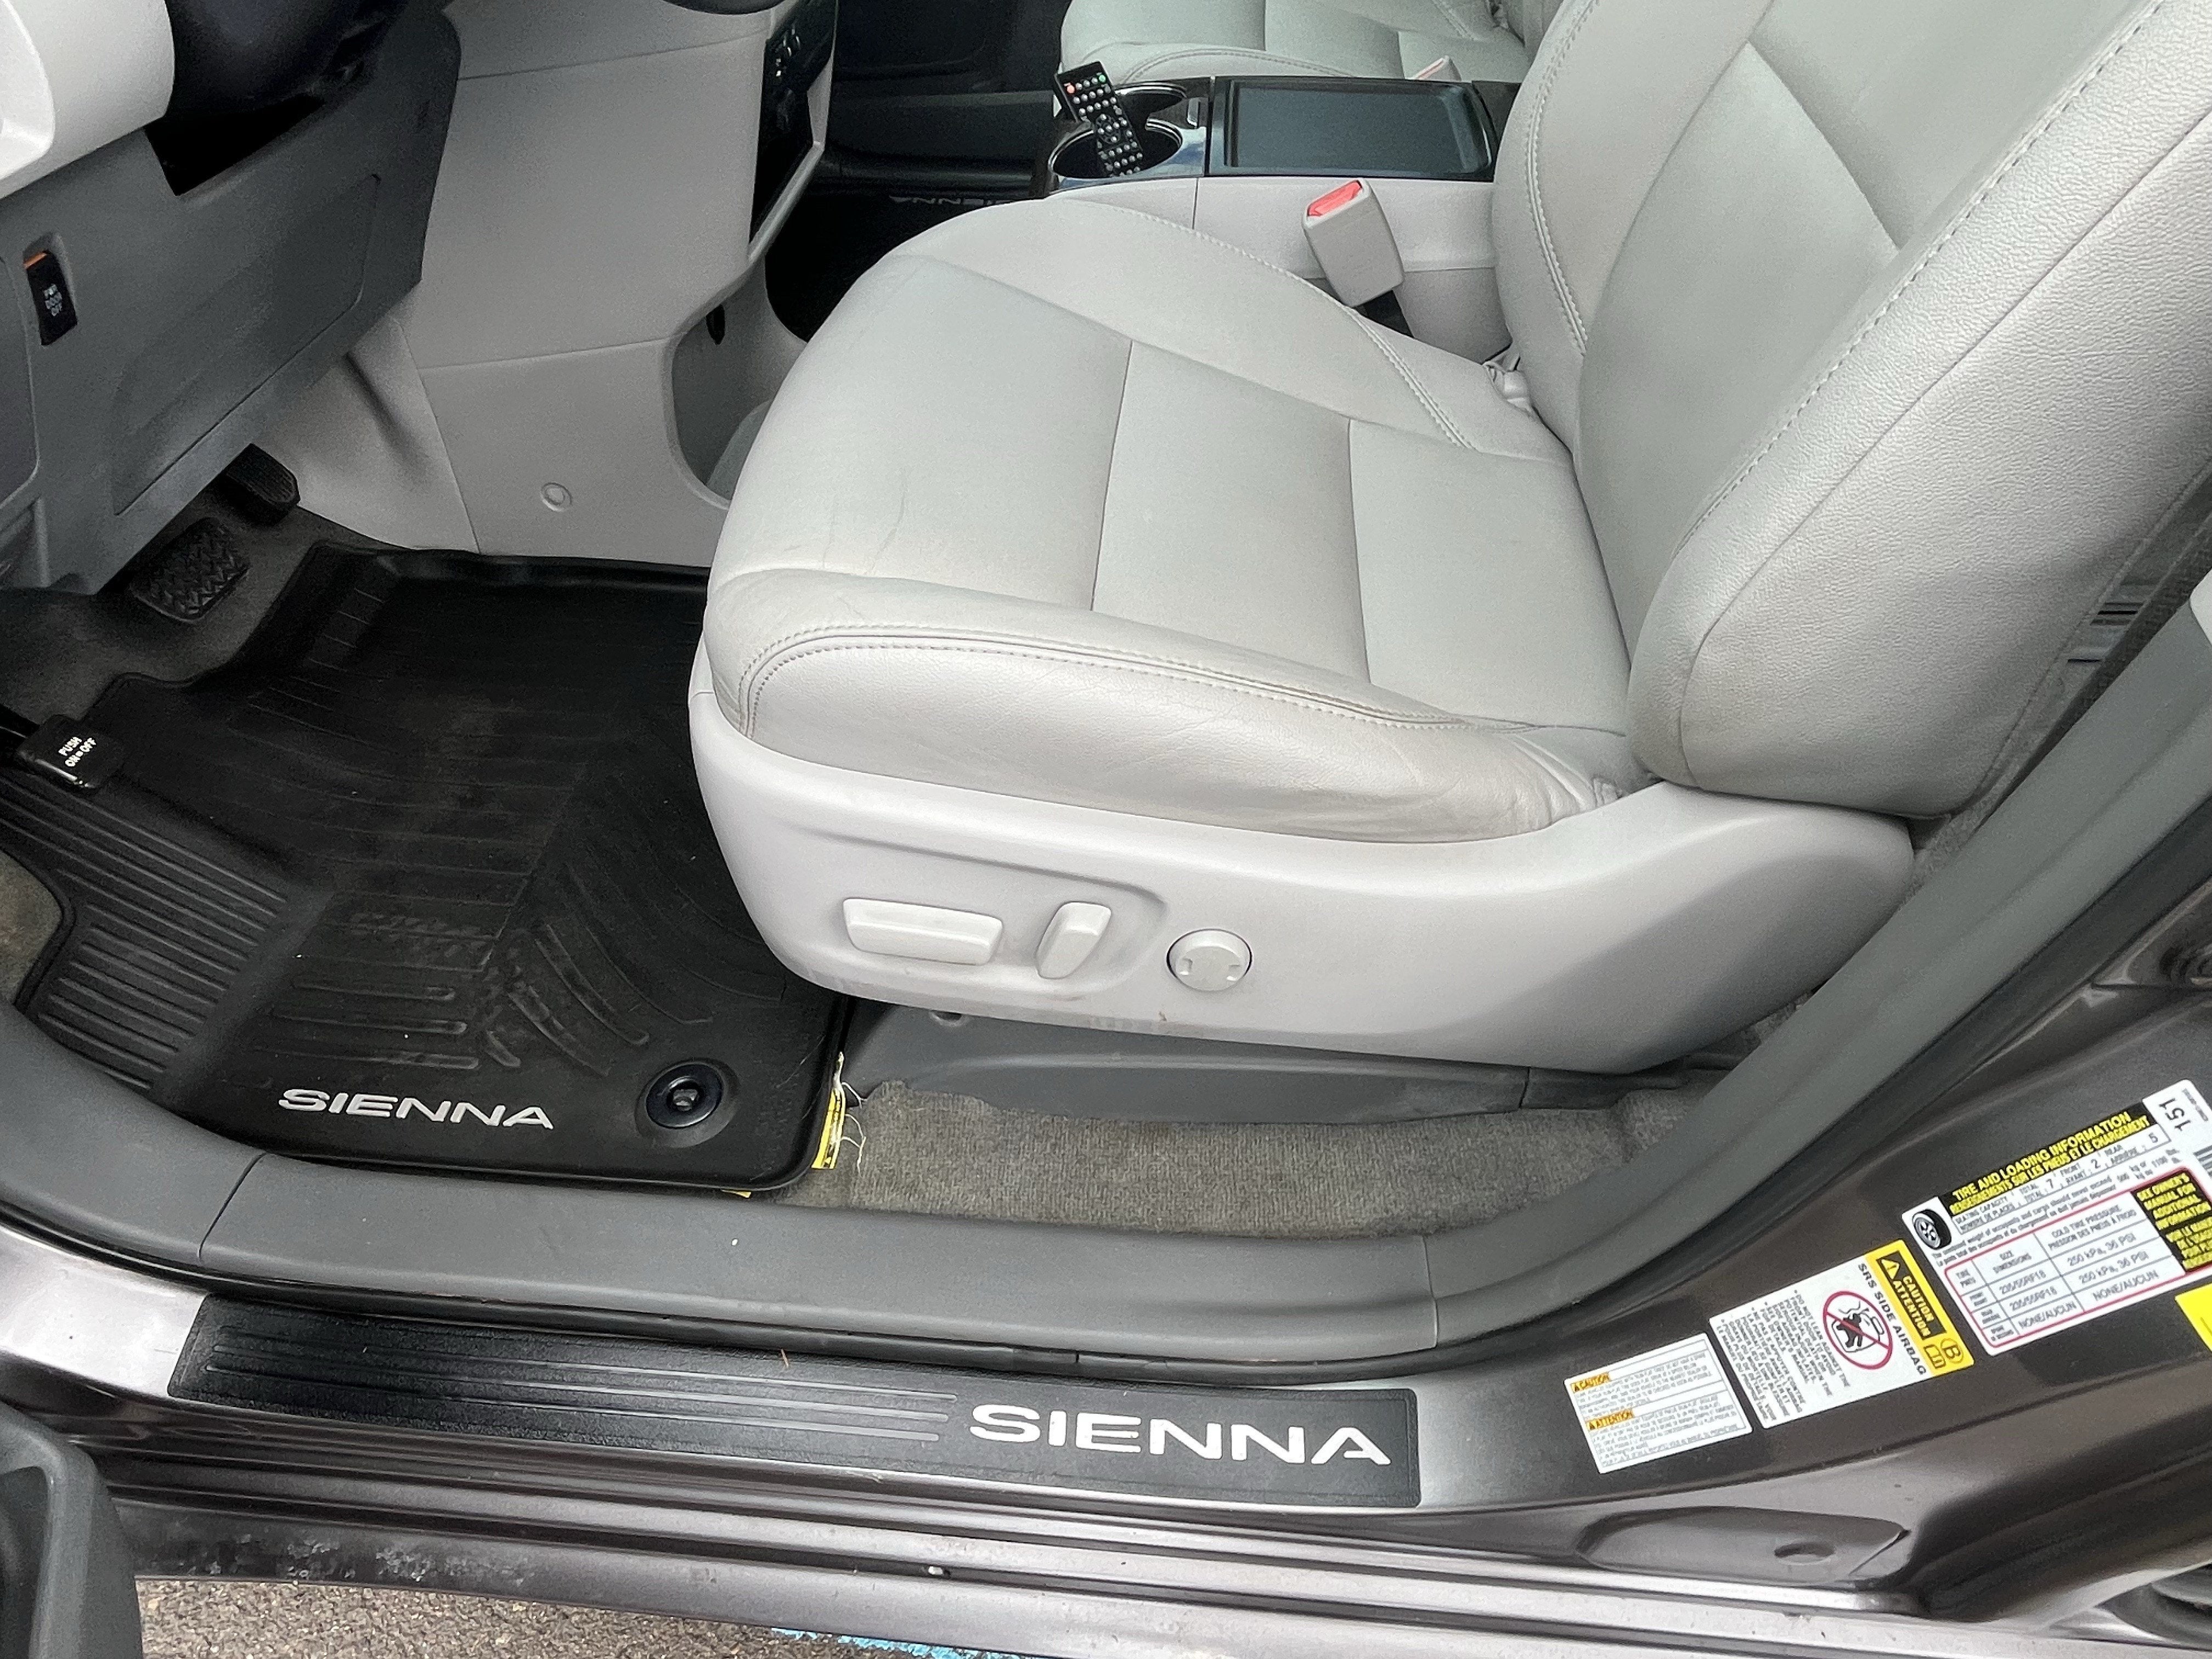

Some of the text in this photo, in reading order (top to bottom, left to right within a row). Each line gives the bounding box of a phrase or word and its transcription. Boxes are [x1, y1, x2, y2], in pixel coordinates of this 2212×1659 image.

[58, 736, 82, 756] PUSH
[278, 1088, 554, 1130] SIENNA
[2158, 1097, 2193, 1133] 151
[2147, 1131, 2159, 1144] 5
[1948, 1114, 2152, 1215] RENSEIGNEMENTS SUR LES PNEUS ET LE CHARGEMENT
[1951, 1109, 2131, 1202] TIRE AND LOADING INFORMATION
[2089, 1158, 2101, 1169] 2
[2045, 1178, 2056, 1189] 7
[2142, 1182, 2197, 1211] MANUAL FOR
[2151, 1192, 2202, 1220] ADDITIONAL
[2154, 1200, 2212, 1231] INFORMATION
[1901, 1275, 1935, 1322] CAUTION
[2091, 1268, 2160, 1301] NONE/AUCUN
[1857, 1262, 1928, 1375] SRS SIDE AIRBAG
[1892, 1278, 1931, 1336] ATTENTION
[2017, 1300, 2078, 1329] NONE/AUCUN
[1577, 1372, 1610, 1390] CAUTION
[1594, 1408, 1634, 1428] ATTENTION
[969, 1404, 1392, 1465] SIENNA
